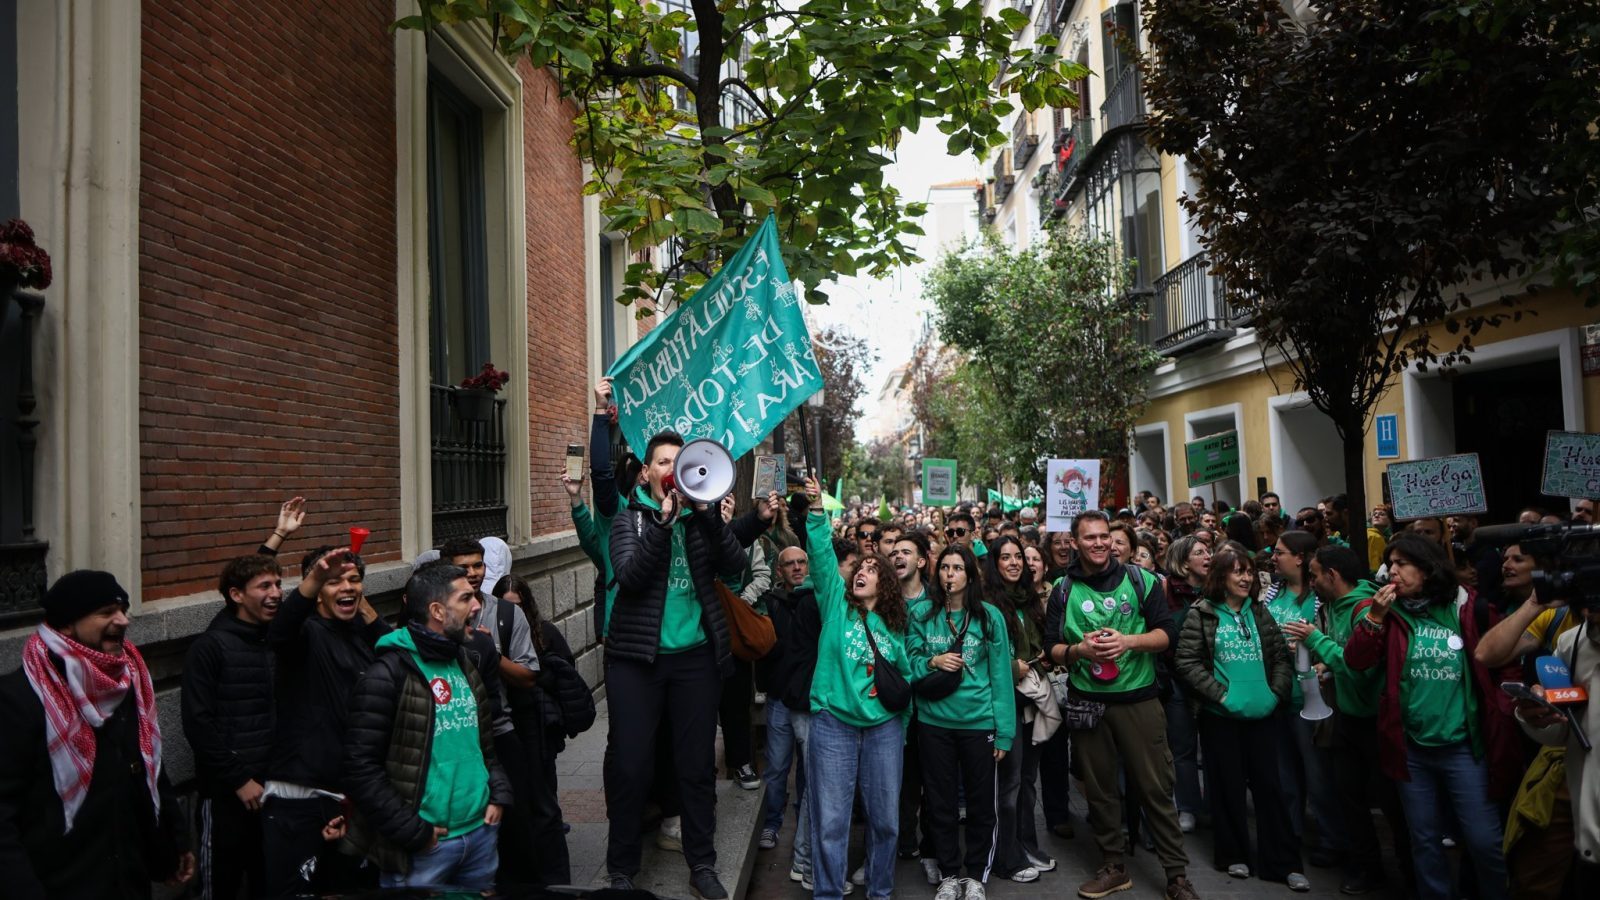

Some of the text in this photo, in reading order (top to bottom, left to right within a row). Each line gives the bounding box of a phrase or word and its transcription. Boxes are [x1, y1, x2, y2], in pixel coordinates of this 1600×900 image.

[1382, 420, 1393, 441] H
[1401, 464, 1472, 494] Huelga
[1423, 488, 1446, 497] IES
[1429, 495, 1460, 509] Carlos
[1544, 664, 1569, 676] tve
[1555, 690, 1579, 699] 360
